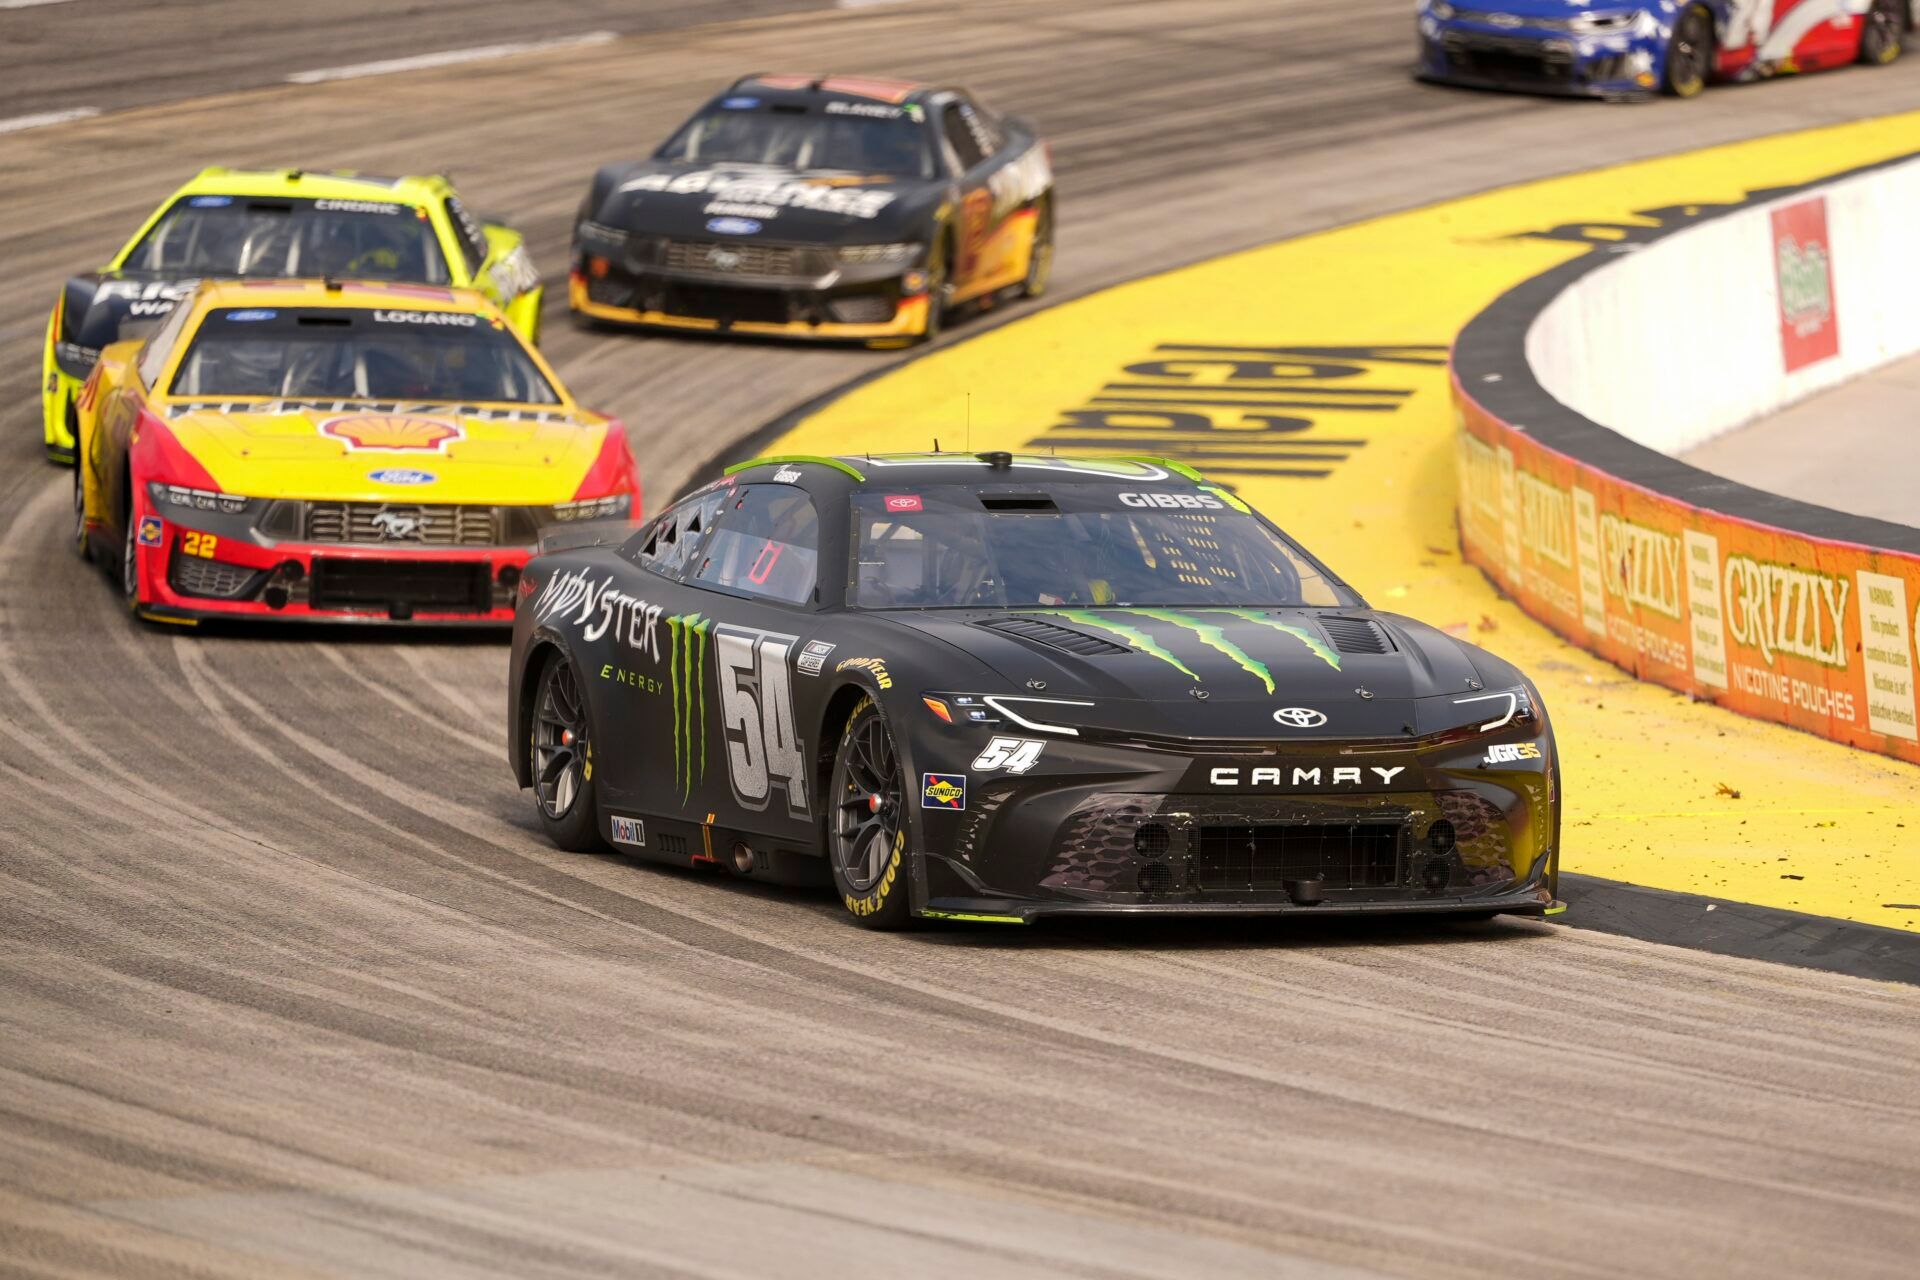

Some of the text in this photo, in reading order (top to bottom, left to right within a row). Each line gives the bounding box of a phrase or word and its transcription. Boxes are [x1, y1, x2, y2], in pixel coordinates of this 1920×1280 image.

[373, 310, 477, 327] LOGANO
[1118, 493, 1223, 509] GIBBS
[184, 531, 218, 559] 22
[1600, 514, 1681, 620] GRIZZLY
[533, 566, 664, 664] MONSTER
[1724, 557, 1849, 666] GRIZZLY
[600, 664, 662, 695] ENERGY
[836, 658, 893, 689] GOODYEAR
[1732, 663, 1855, 721] NICOTINE POUCHES
[713, 622, 814, 823] 54
[971, 736, 1047, 774] 54
[927, 786, 962, 798] SUNOCO
[1210, 767, 1405, 785] CAMRY
[846, 829, 905, 917] GOODYEAR
